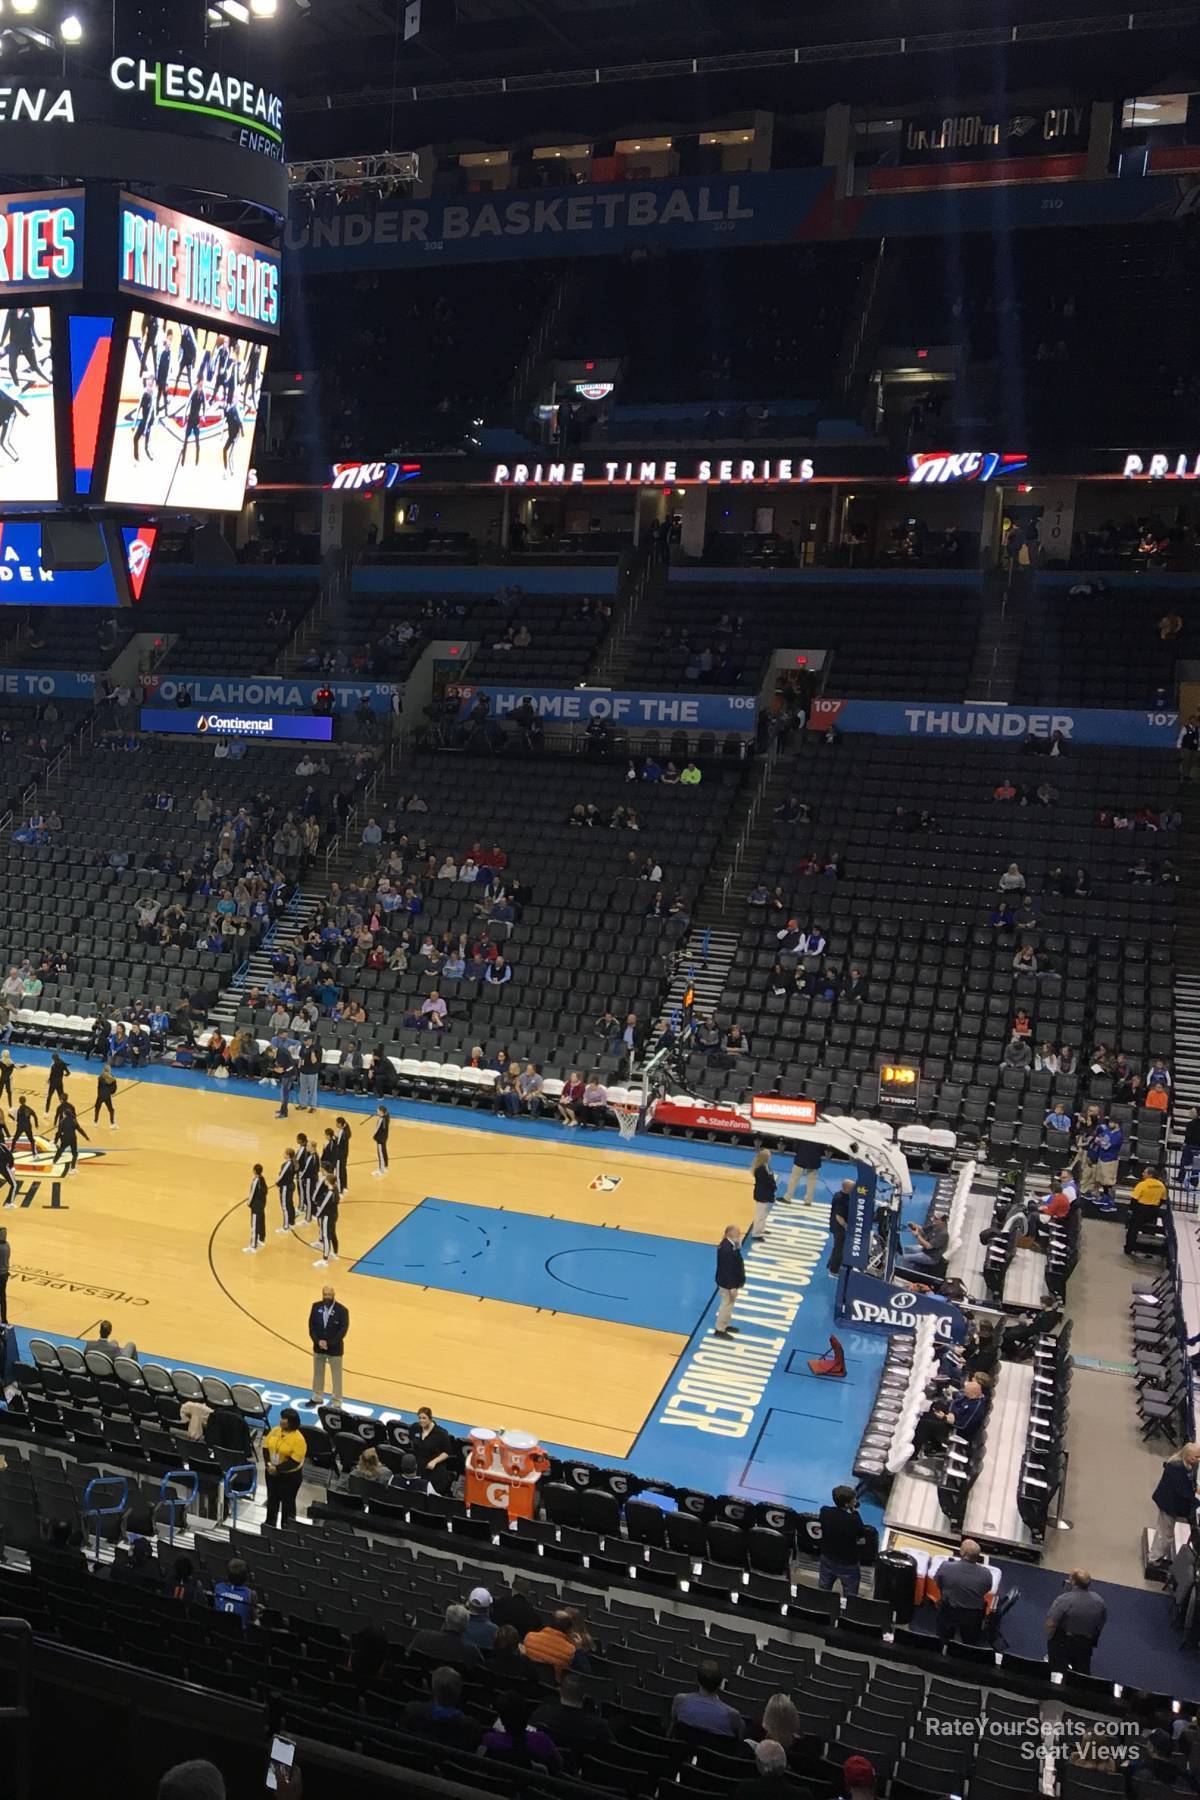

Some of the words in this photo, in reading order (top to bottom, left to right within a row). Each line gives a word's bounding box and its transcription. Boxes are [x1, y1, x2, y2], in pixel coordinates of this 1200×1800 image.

[111, 56, 282, 130] CHESAPEAKE
[1043, 108, 1085, 141] CITY
[442, 185, 754, 240] BASKETBALL
[122, 210, 179, 293] PRIME
[184, 235, 222, 309] TIME
[227, 246, 279, 325] SERIES
[495, 463, 585, 483] PRIME
[606, 461, 677, 481] TIME
[700, 459, 815, 481] SERIES
[1051, 501, 1063, 538] 210
[24, 675, 55, 695] TO
[76, 673, 95, 684] 104
[139, 675, 159, 686] 105
[376, 684, 397, 695] 105
[496, 694, 580, 718] HOME
[589, 697, 630, 720] OF
[639, 699, 699, 723] THE
[728, 697, 755, 710] 106
[814, 700, 841, 712] 107
[209, 715, 273, 731] Continental
[905, 709, 1074, 739] THUNDER
[1146, 712, 1178, 726] 107
[852, 1198, 865, 1258] DRAFTKINGS
[660, 1328, 785, 1438] THUNDER
[325, 1413, 342, 1429] G
[357, 1423, 375, 1440] G
[393, 1427, 410, 1445] G
[572, 1467, 590, 1486] G
[609, 1475, 628, 1493] G
[486, 1483, 509, 1508] G
[685, 1495, 704, 1513] G
[725, 1502, 744, 1520] G
[766, 1509, 785, 1527] G
[807, 1521, 823, 1538] G
